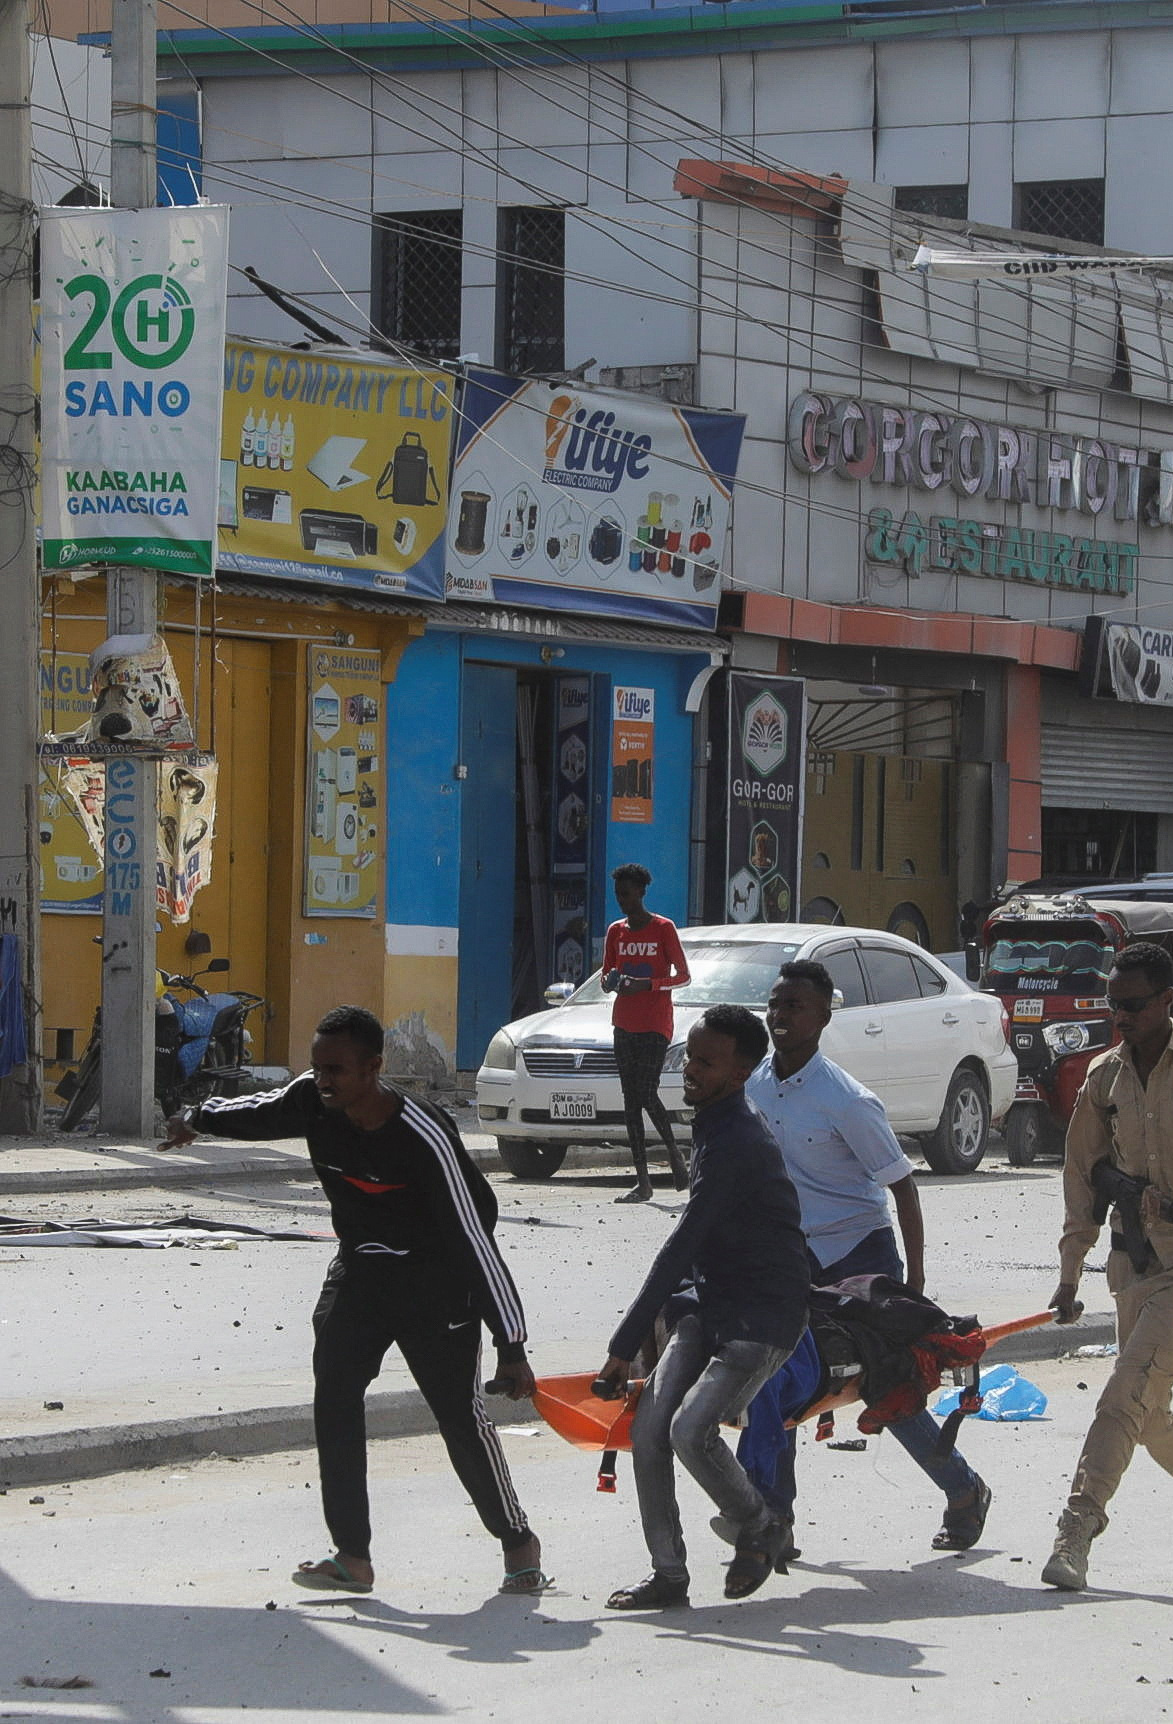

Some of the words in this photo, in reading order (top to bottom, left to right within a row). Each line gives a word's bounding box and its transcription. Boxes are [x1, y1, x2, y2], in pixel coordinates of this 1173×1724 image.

[63, 274, 195, 370] 20
[65, 380, 191, 417] SANO
[263, 356, 395, 413] COMPANY
[399, 376, 448, 421] LLC
[788, 390, 1032, 503] GORGOR
[66, 471, 187, 493] KAABAHA
[545, 470, 577, 485] ELECTRIC
[578, 476, 613, 491] COMPANY
[66, 495, 189, 516] GANACSIGA
[733, 779, 794, 802] GOR-GOR
[108, 862, 141, 891] 175
[112, 893, 131, 916] M
[619, 942, 658, 956] LOVE
[1018, 977, 1058, 991] Motorcycle
